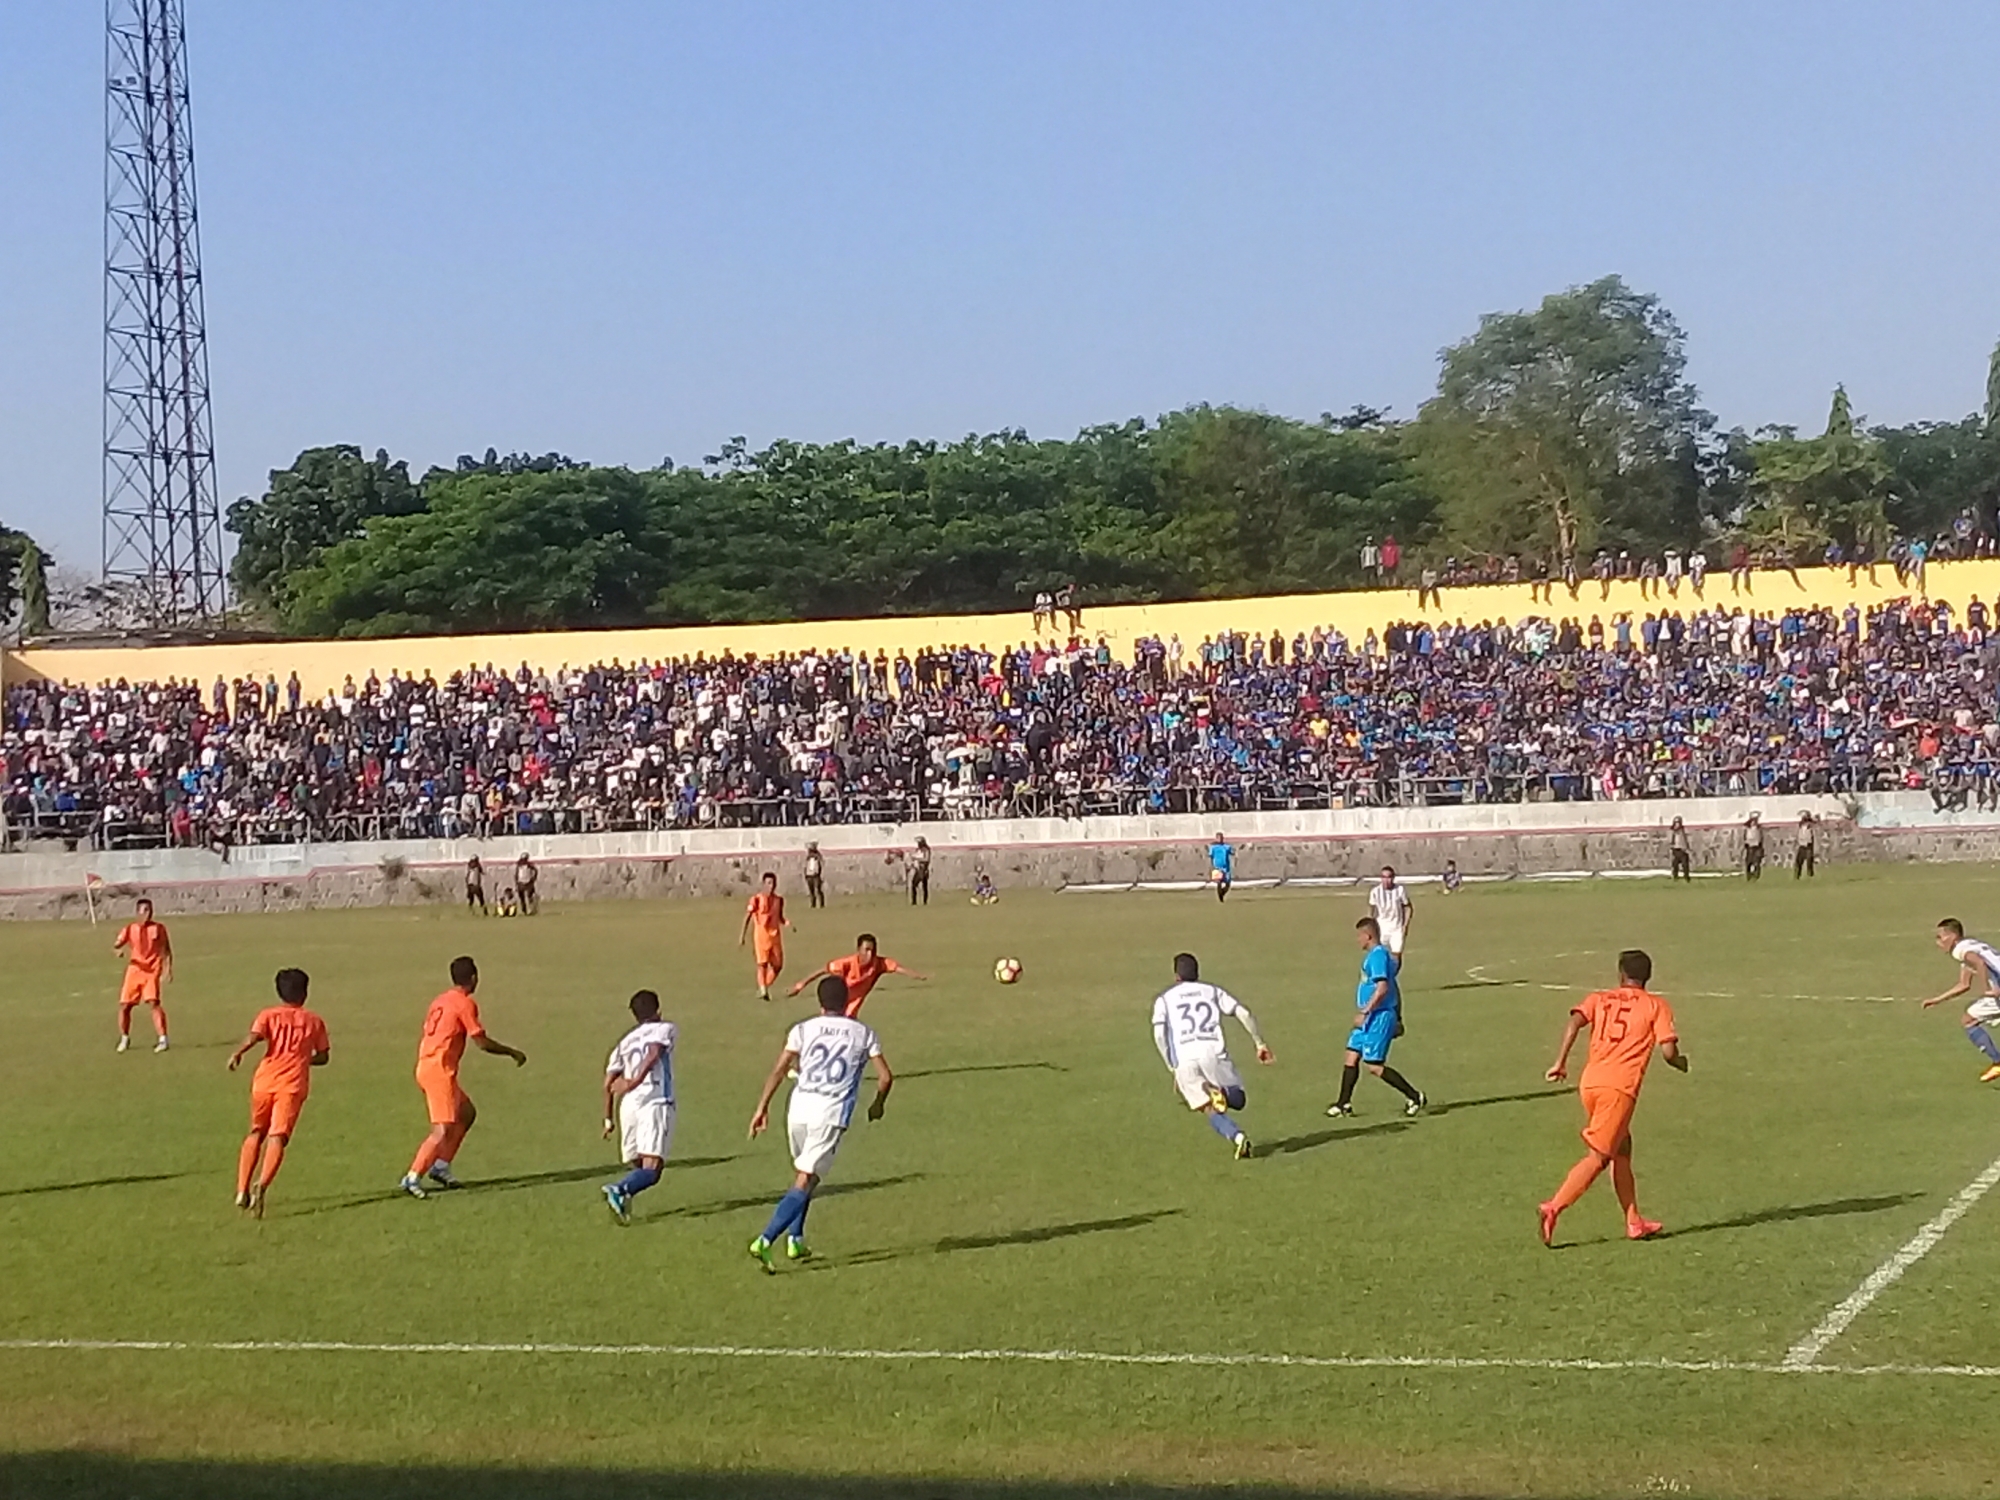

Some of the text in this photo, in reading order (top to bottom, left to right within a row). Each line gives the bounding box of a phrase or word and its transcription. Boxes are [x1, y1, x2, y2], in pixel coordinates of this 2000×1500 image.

[1176, 1001, 1213, 1034] 32
[1600, 1003, 1631, 1042] 15
[807, 1042, 848, 1084] 26
